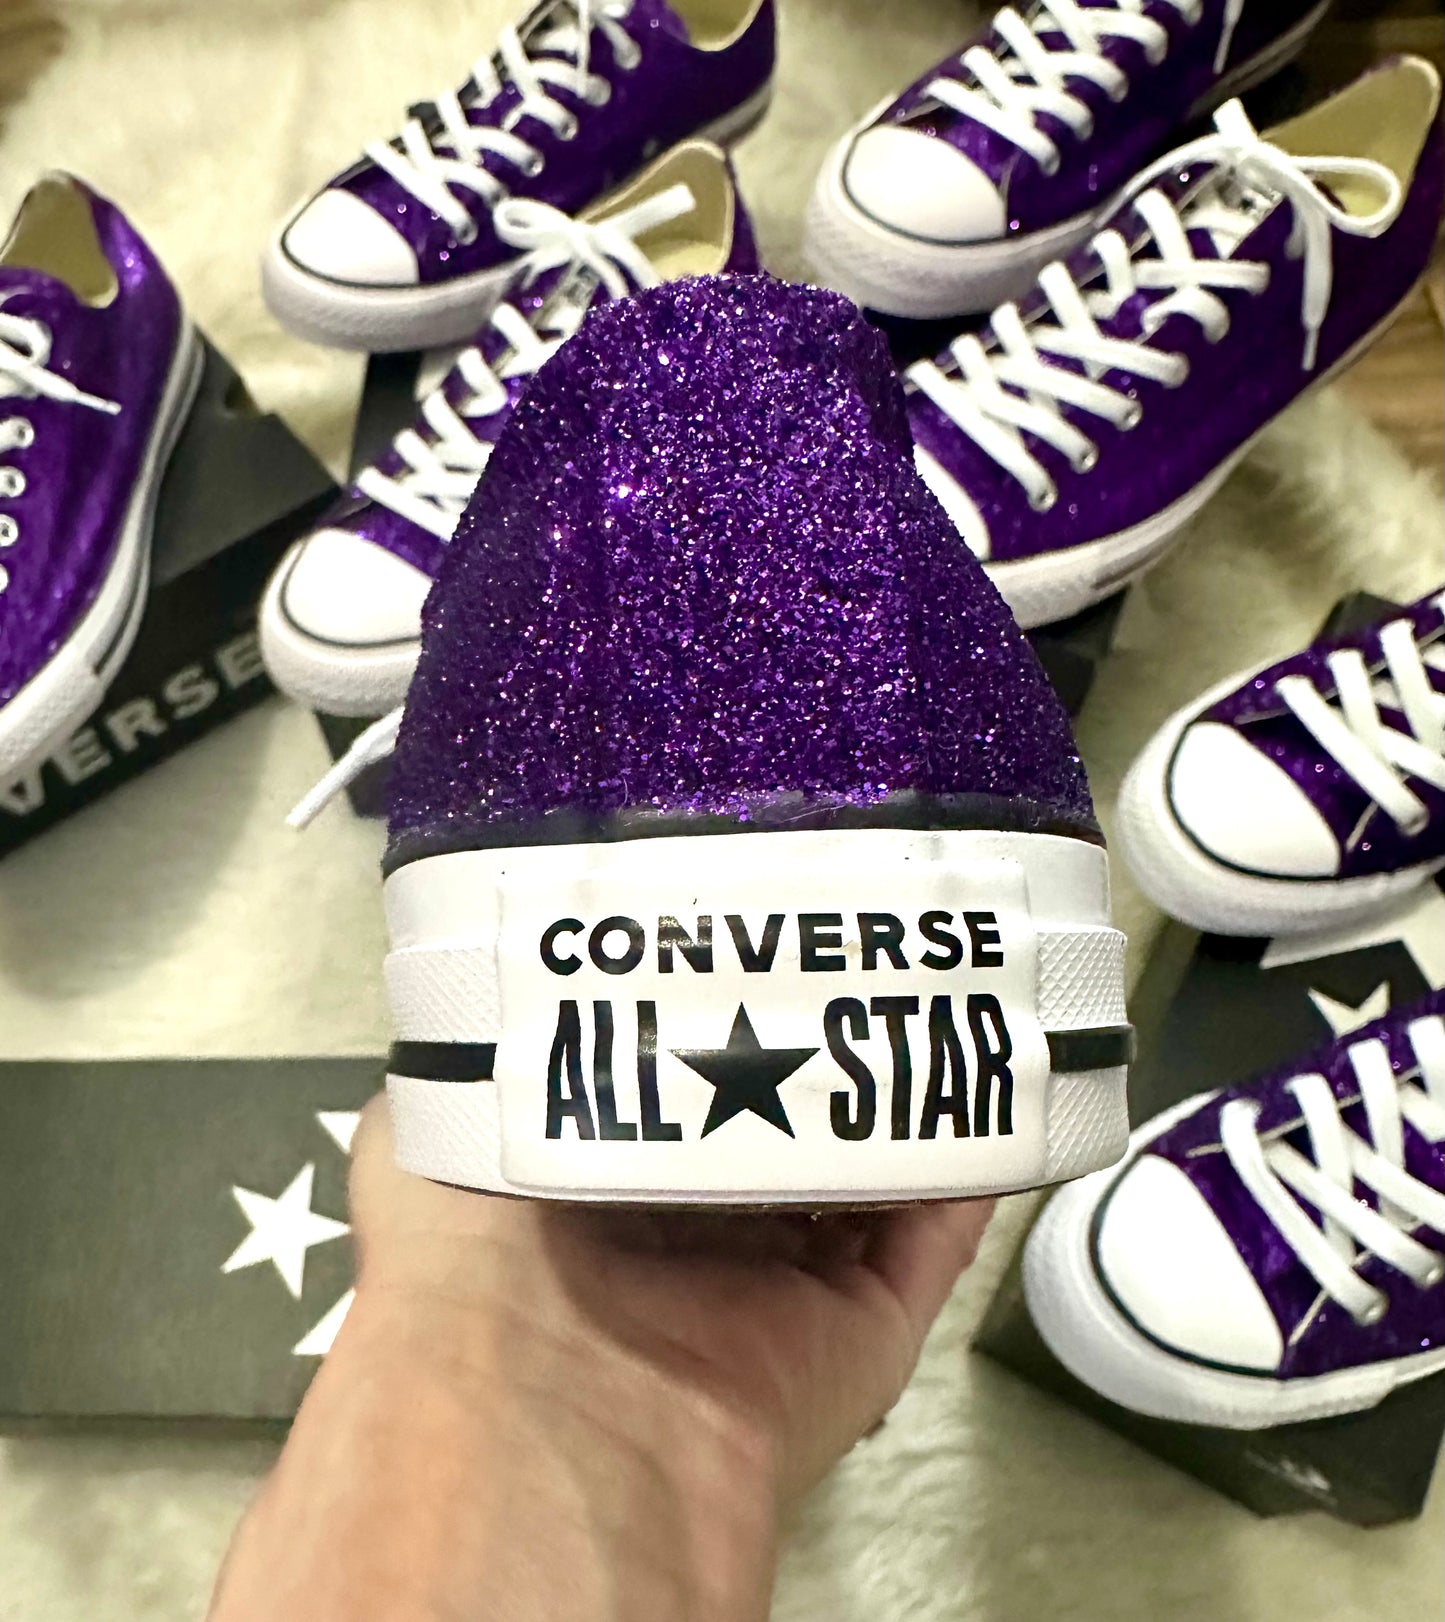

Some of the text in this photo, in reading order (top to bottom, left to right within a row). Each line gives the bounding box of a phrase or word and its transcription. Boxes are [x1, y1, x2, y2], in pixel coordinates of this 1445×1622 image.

[540, 911, 1003, 976] CONVERSE
[545, 994, 1013, 1141] ALL STAR
